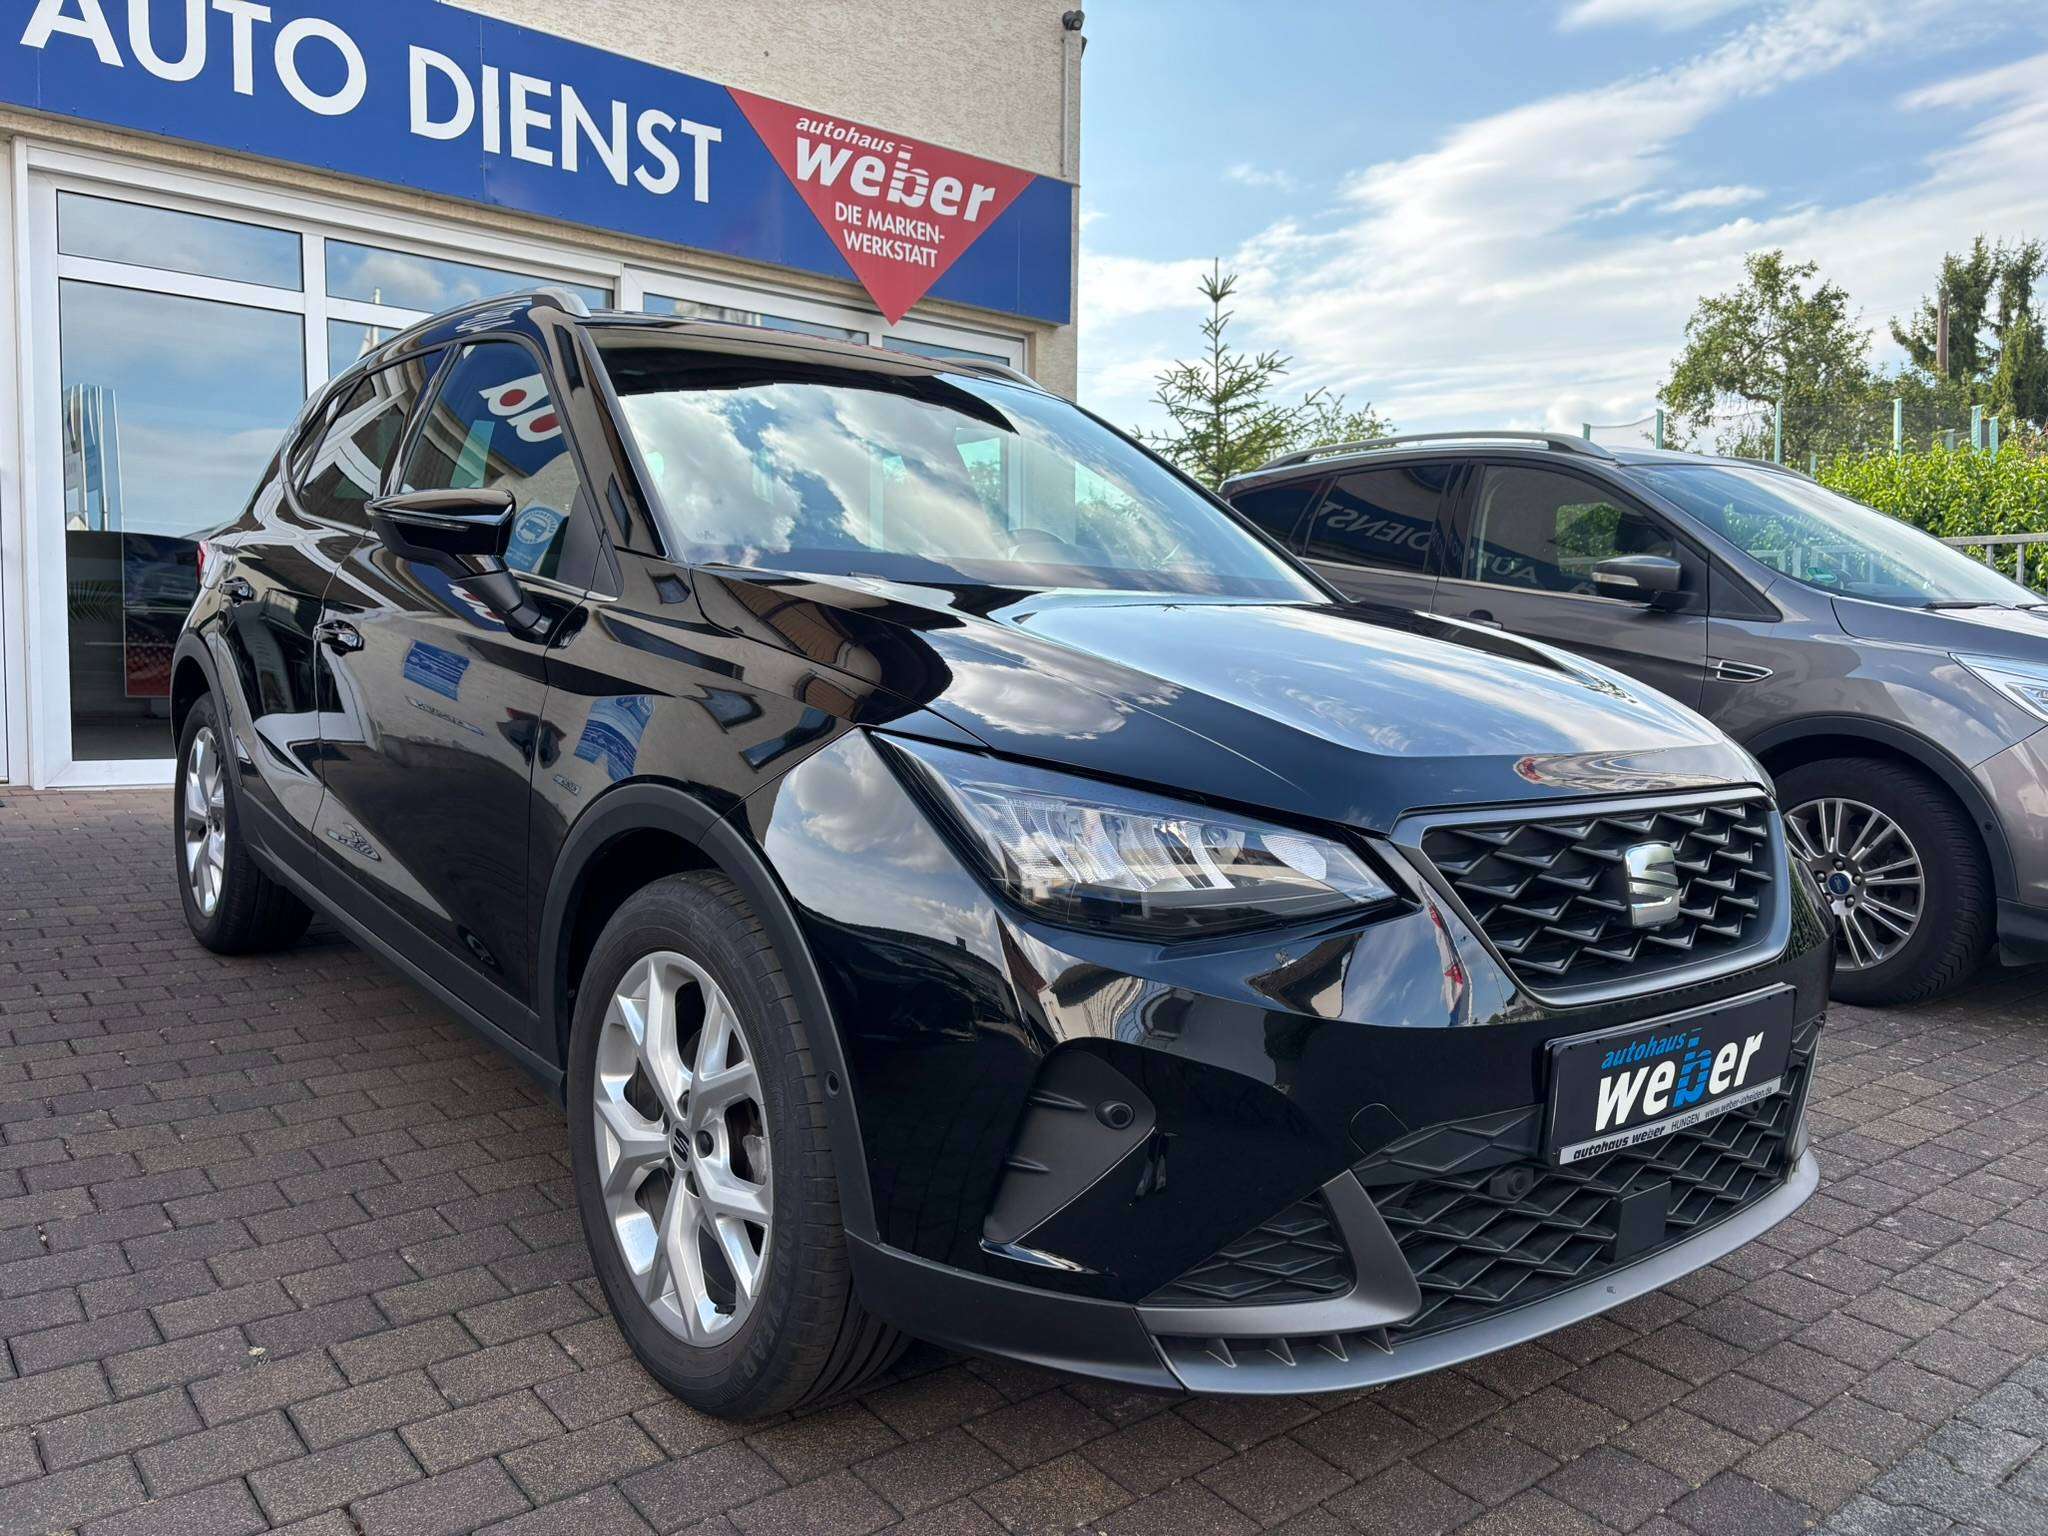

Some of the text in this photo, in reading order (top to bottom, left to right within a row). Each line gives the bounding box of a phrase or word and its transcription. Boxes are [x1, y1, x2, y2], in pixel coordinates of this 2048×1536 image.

[20, 0, 723, 204] AUTO DIENST
[796, 116, 896, 155] autohaus
[796, 137, 997, 222] weber
[835, 201, 945, 244] DIE MARKEN-
[843, 229, 938, 268] WERKSTATT
[1601, 1030, 1686, 1071] autohaus
[1595, 1027, 1764, 1132] weber
[1573, 1135, 1629, 1160] autohaus
[1631, 1124, 1666, 1144] weber
[1671, 1111, 1701, 1132] HUNGEN
